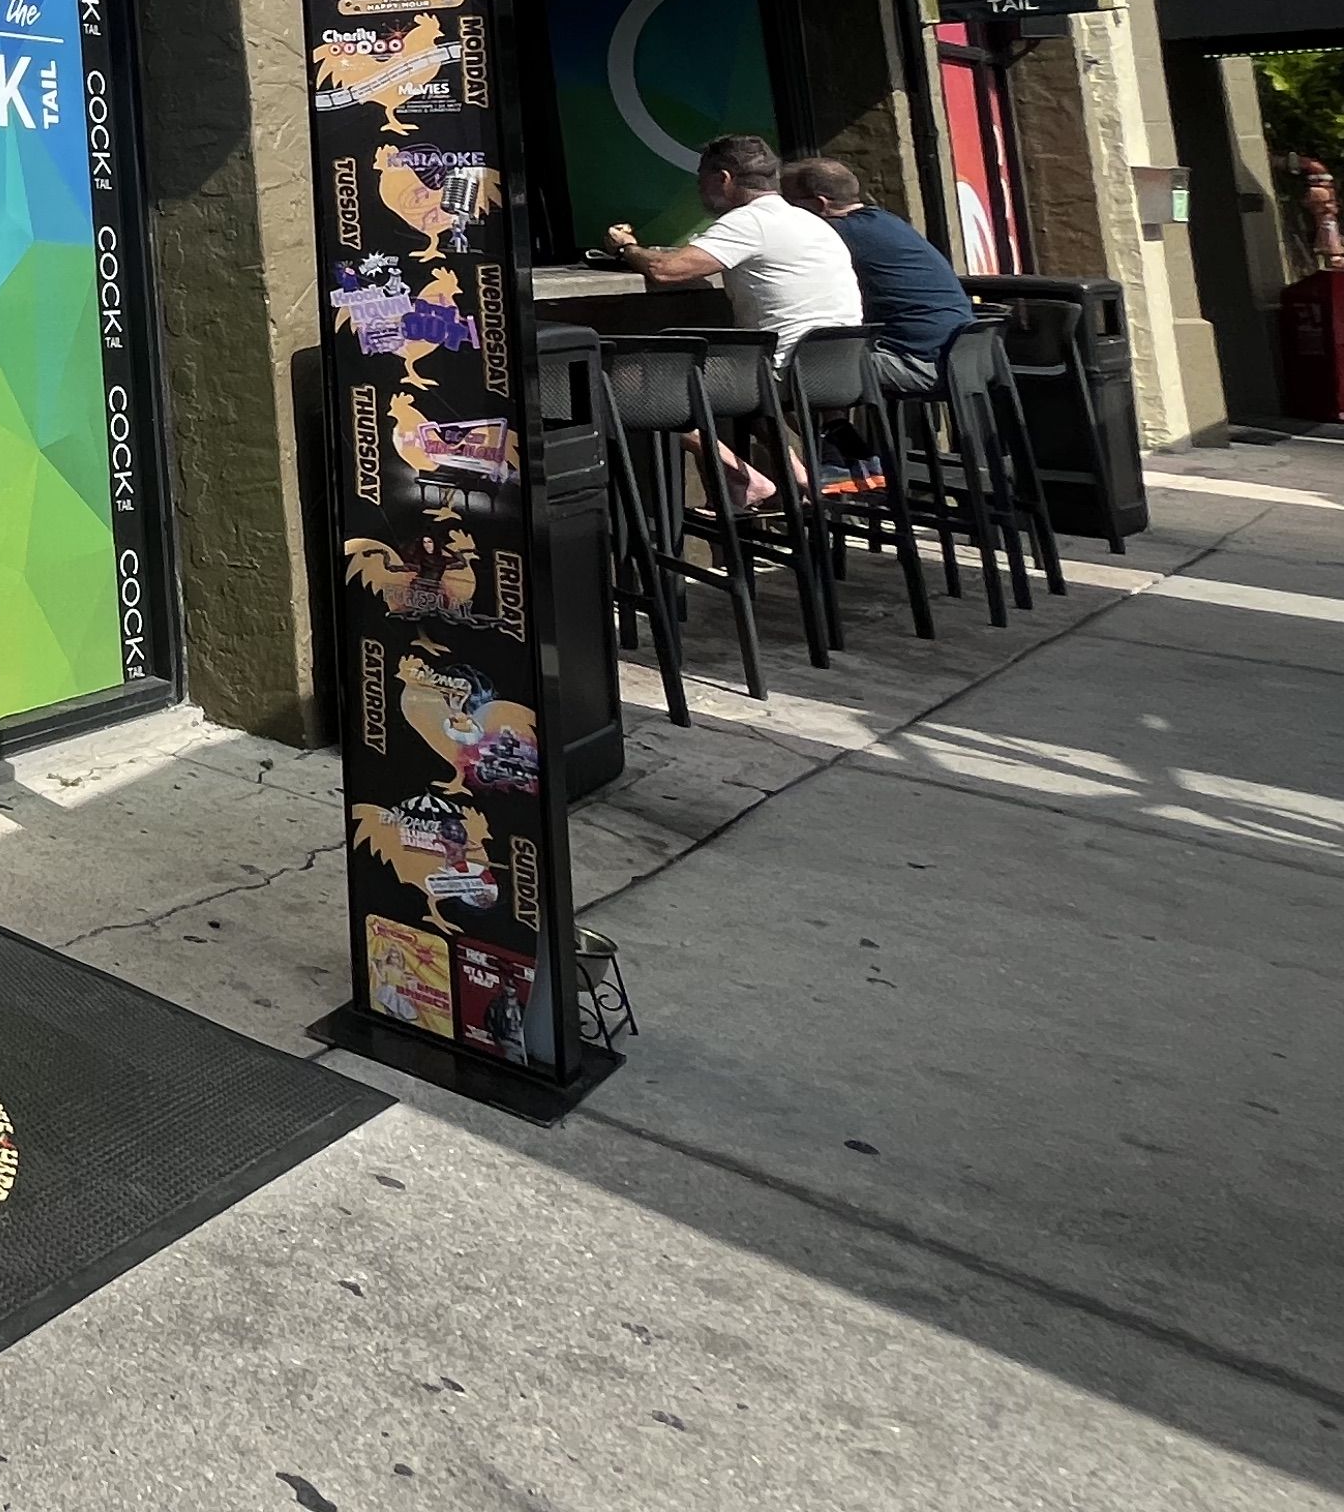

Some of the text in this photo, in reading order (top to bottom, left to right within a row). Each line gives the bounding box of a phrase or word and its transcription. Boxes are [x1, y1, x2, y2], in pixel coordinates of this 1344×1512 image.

[83, 23, 101, 36] TAIL
[367, 0, 430, 12] HAPPY HOUR
[43, 59, 60, 129] TAIL
[86, 70, 112, 176] COCK
[94, 176, 112, 190] TAIL
[387, 151, 486, 168] KARAOKE
[97, 226, 123, 337] COCK
[104, 336, 123, 349] TAIL
[108, 385, 134, 499] COCK
[353, 384, 380, 506] THURSDAY
[115, 498, 134, 512] TAIL
[119, 549, 146, 666] COCK
[496, 550, 526, 643] FRIDAY
[127, 665, 145, 680] TAIL
[363, 638, 386, 755] SATURDAY
